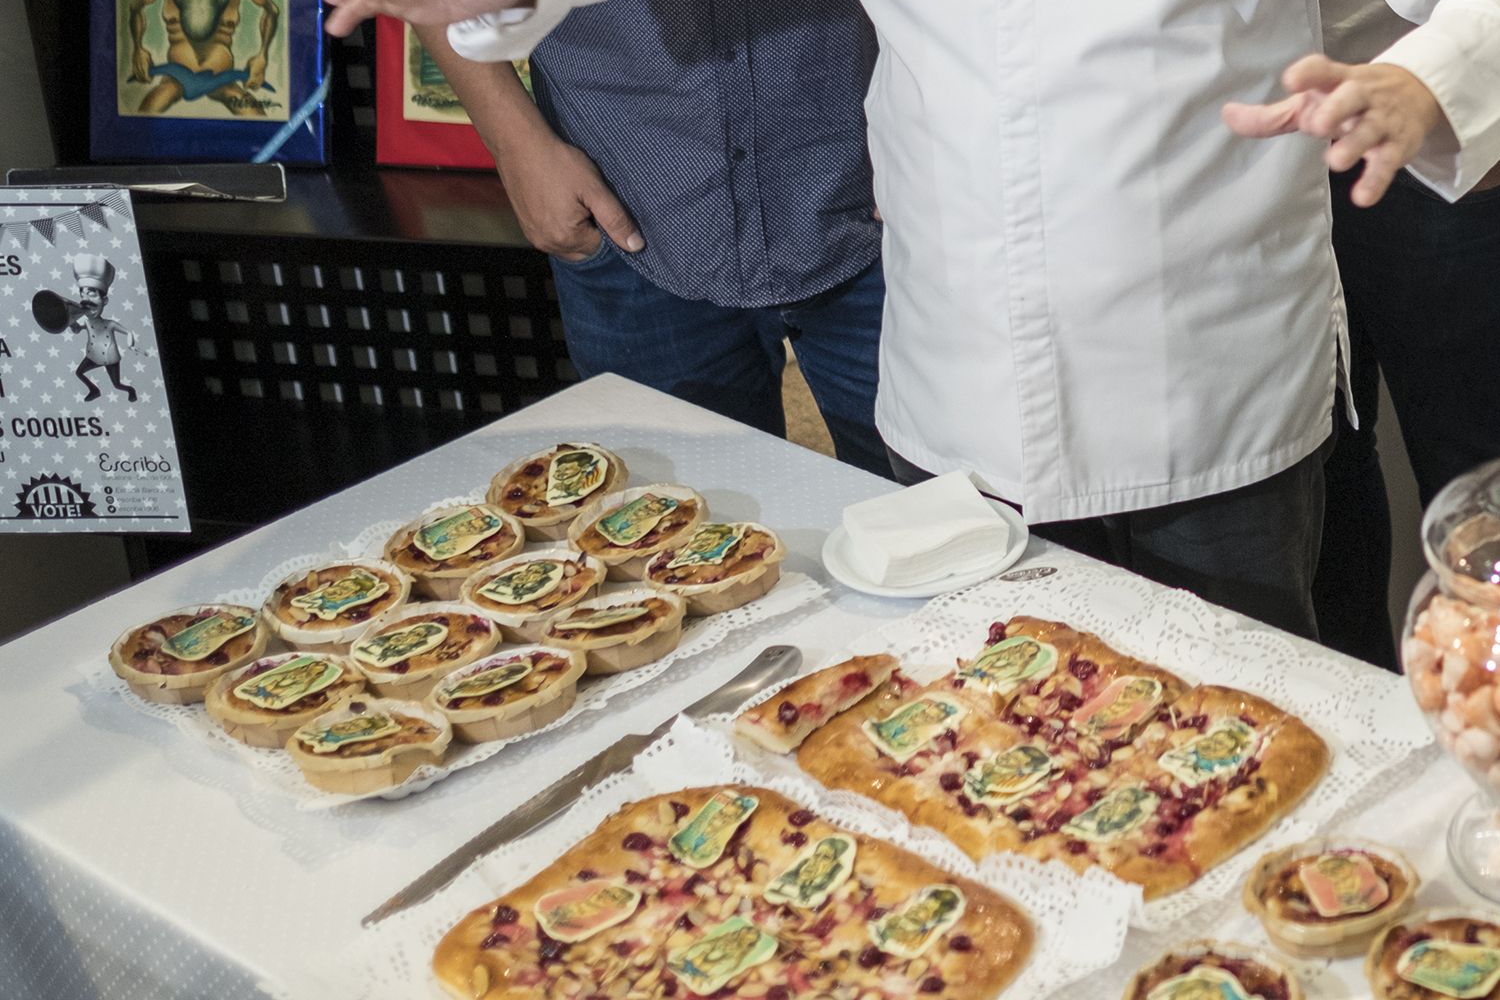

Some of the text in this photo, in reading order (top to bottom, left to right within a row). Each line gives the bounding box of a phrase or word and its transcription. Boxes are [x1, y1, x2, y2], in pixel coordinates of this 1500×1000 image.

[11, 416, 111, 438] COQUES.
[99, 452, 172, 473] Escribà
[31, 504, 82, 518] VOTE!
